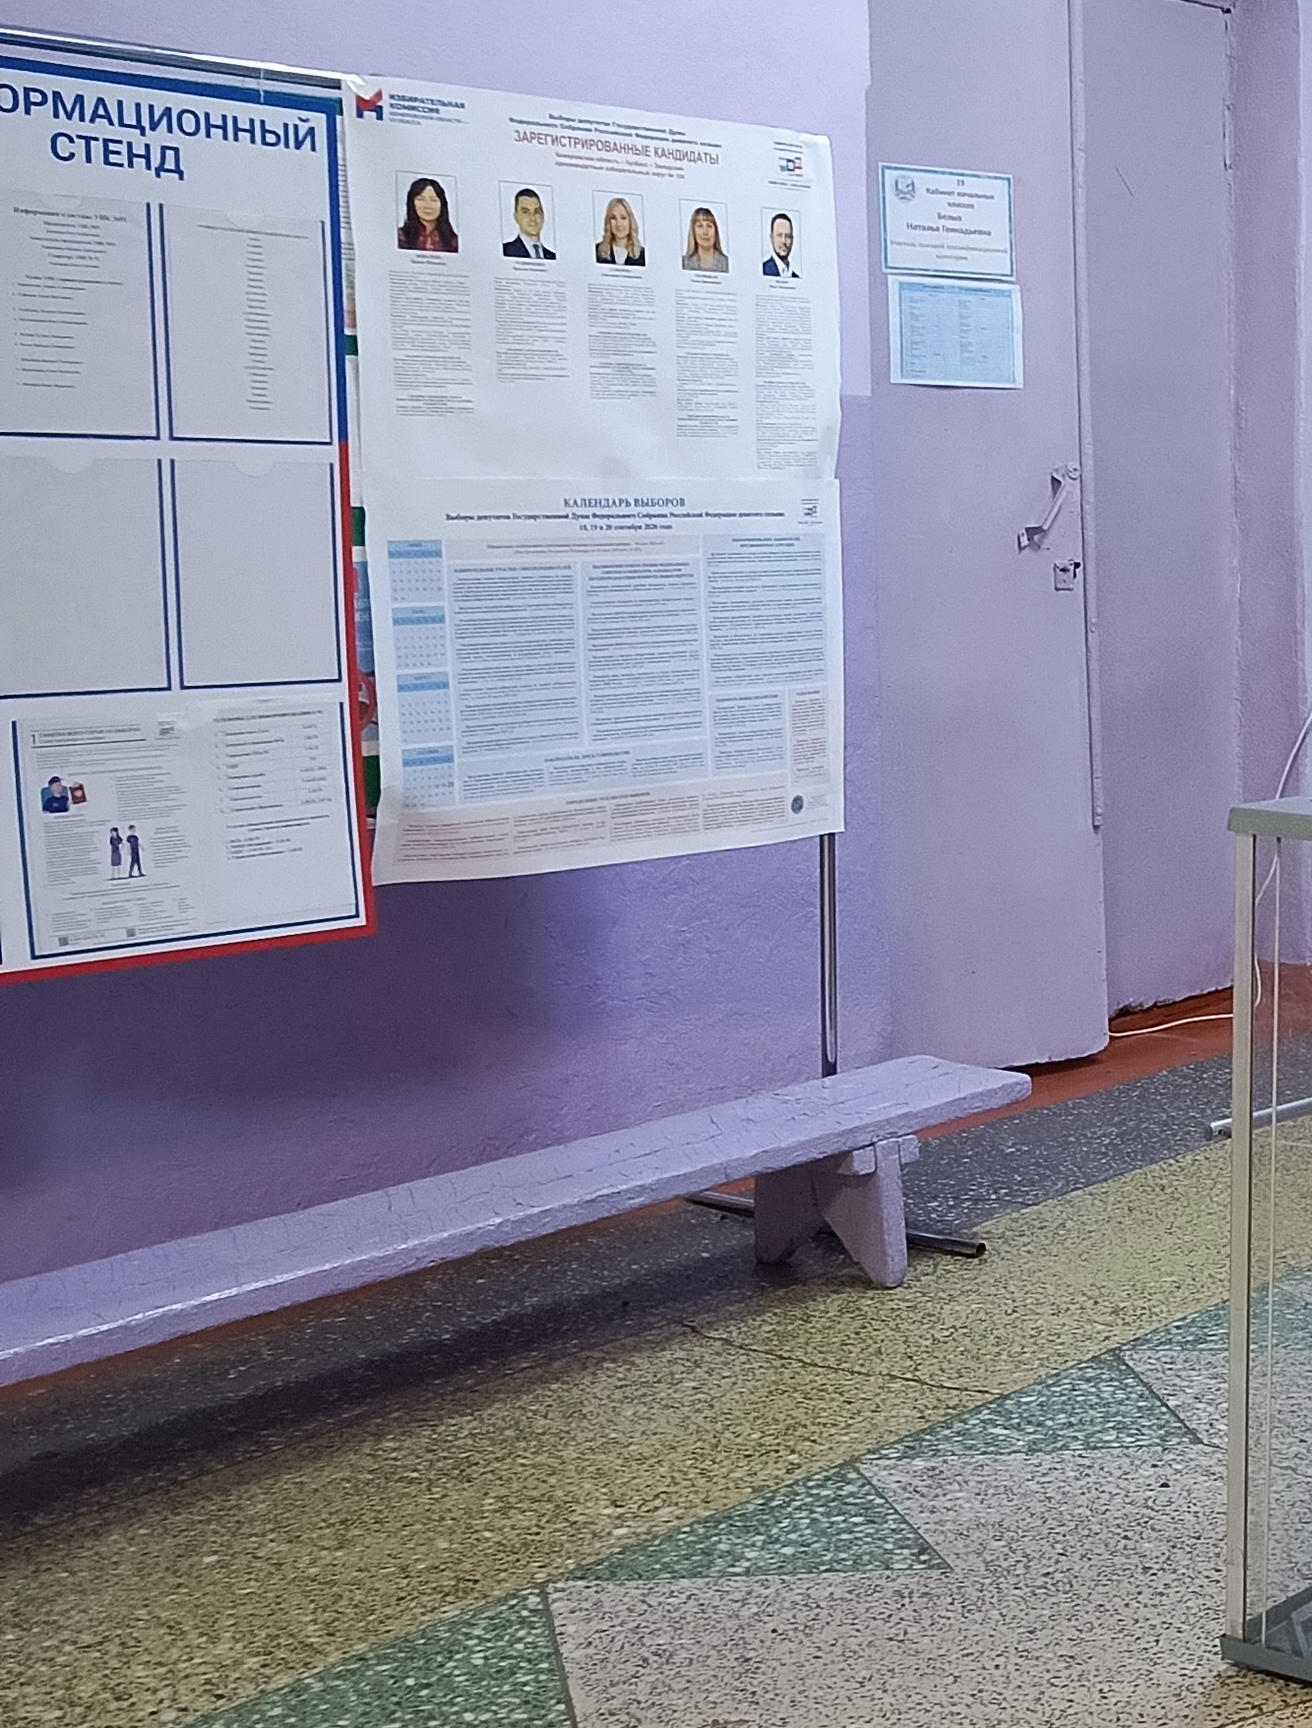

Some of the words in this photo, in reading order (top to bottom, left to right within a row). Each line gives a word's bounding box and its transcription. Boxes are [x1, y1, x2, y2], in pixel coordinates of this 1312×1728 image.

[0, 83, 317, 152] ОРМАЦИОННЫЙ
[50, 131, 184, 181] СТЕНД
[514, 130, 651, 157] ЗАРЕГИСТРИРОВАННЫЕ
[654, 147, 719, 164] КАНДИДАТЫ
[563, 498, 631, 508] КАЛЕНДАРЬ
[634, 498, 686, 507] ВЫБОРОВ
